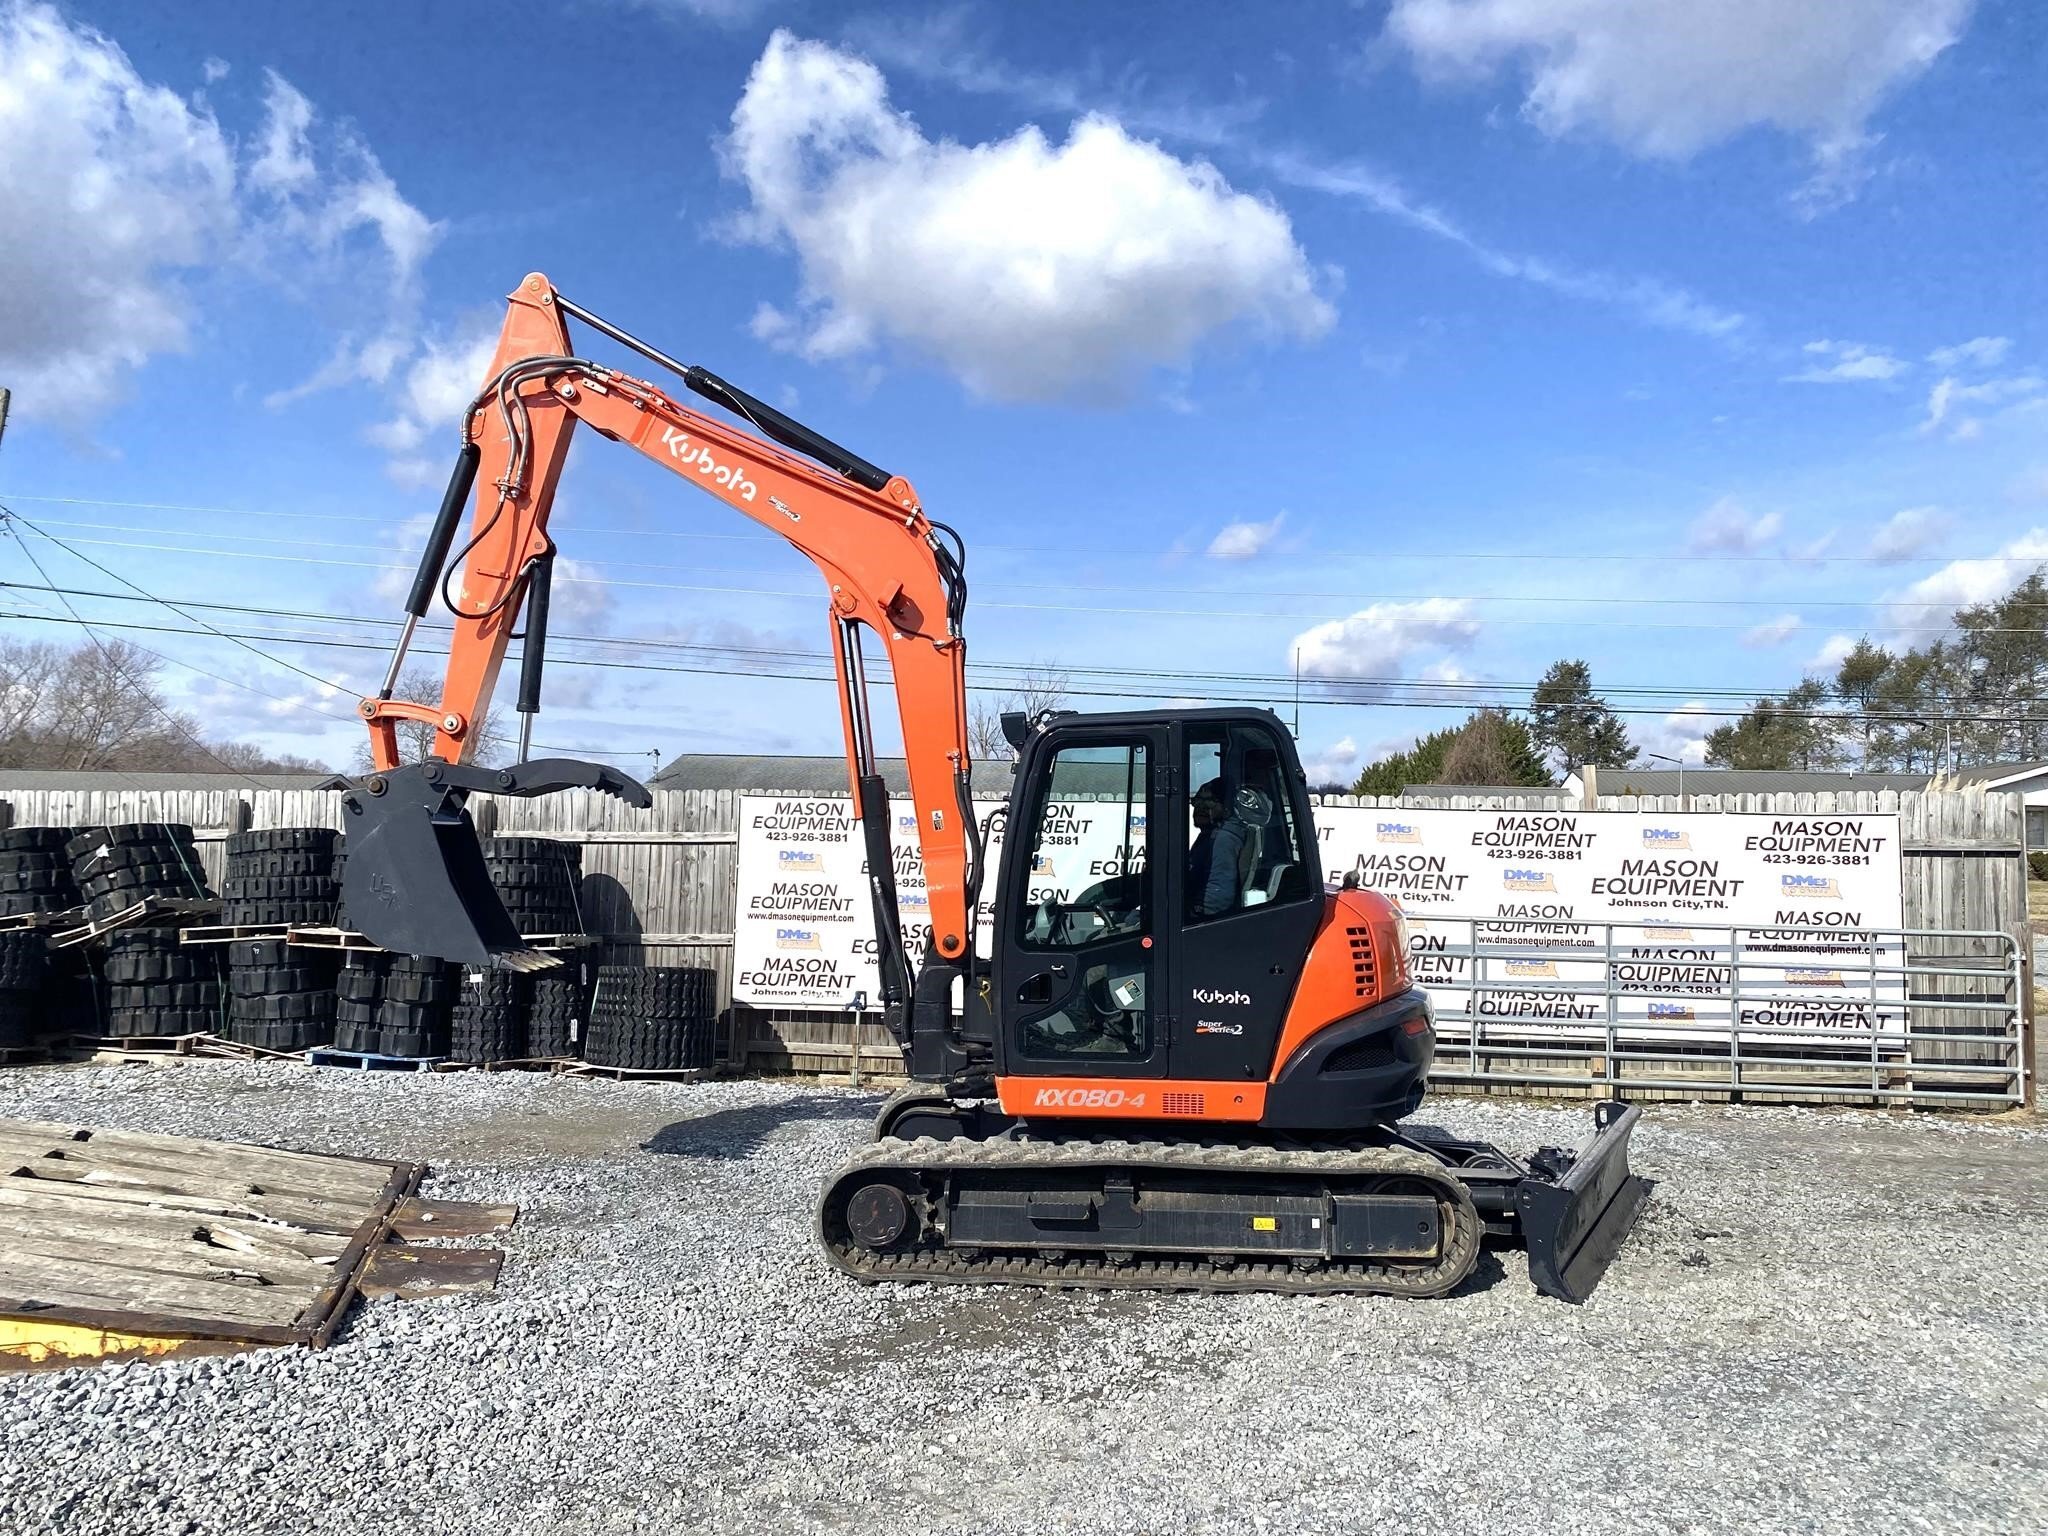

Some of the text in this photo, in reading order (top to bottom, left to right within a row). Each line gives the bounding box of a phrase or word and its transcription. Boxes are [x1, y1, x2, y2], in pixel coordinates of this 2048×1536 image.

[661, 426, 758, 502] Kubota
[774, 802, 845, 816] MASON
[752, 815, 861, 832] EQUIPMENT
[1496, 817, 1577, 832] MASON
[1772, 821, 1863, 836] MASON
[765, 832, 849, 843] 423-926-3881
[1471, 832, 1597, 848] EQUIPMENT
[1744, 836, 1887, 853] EQUIPMENT
[1486, 849, 1582, 860] 423-926-3881
[1762, 854, 1870, 865] 423-926-3881
[1356, 854, 1446, 872] MASON
[1621, 859, 1719, 877] MASON
[1328, 870, 1469, 891] EUIPMENT
[1591, 877, 1745, 897] EQUIPMENT
[771, 883, 838, 896] MASON
[750, 896, 854, 911] EQUIPMENT
[1402, 892, 1455, 903] City,TN.
[1607, 898, 1729, 910] Johnson City,TN.
[747, 911, 855, 923] www.dmasonequipment.com
[1497, 903, 1574, 919] MASON
[1774, 910, 1862, 927] MASON
[1477, 935, 1596, 948] ww.dmasonequipment.com
[1744, 943, 1886, 955] www.dmasonequipment.cm
[763, 957, 837, 973] MASON
[739, 972, 856, 988] EQUIPMENT
[751, 988, 797, 997] Johnson
[1193, 989, 1250, 1005] Kubota
[1197, 1020, 1223, 1028] Super
[1740, 1010, 1892, 1030] EQUIPMENT
[1034, 1088, 1146, 1108] KX080-4
